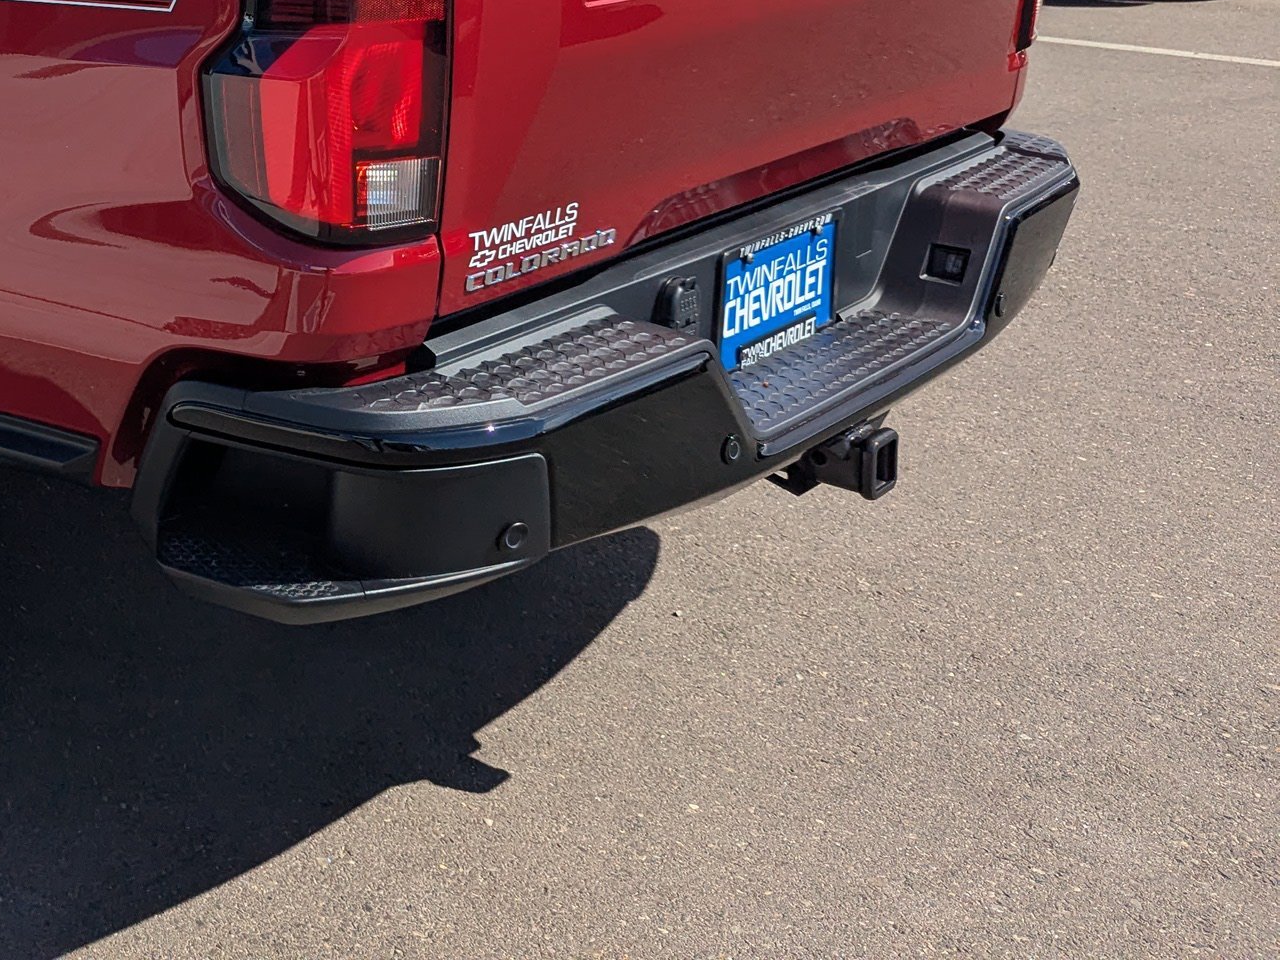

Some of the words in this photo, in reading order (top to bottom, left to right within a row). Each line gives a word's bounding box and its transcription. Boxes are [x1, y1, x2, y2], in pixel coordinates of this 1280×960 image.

[469, 202, 579, 251] TWINFALLS
[498, 222, 577, 259] CHEVROLET
[465, 228, 616, 292] COLORADO
[723, 259, 827, 338] CHEVROLET
[741, 340, 765, 359] TWIN
[764, 317, 817, 357] CHEVROLET
